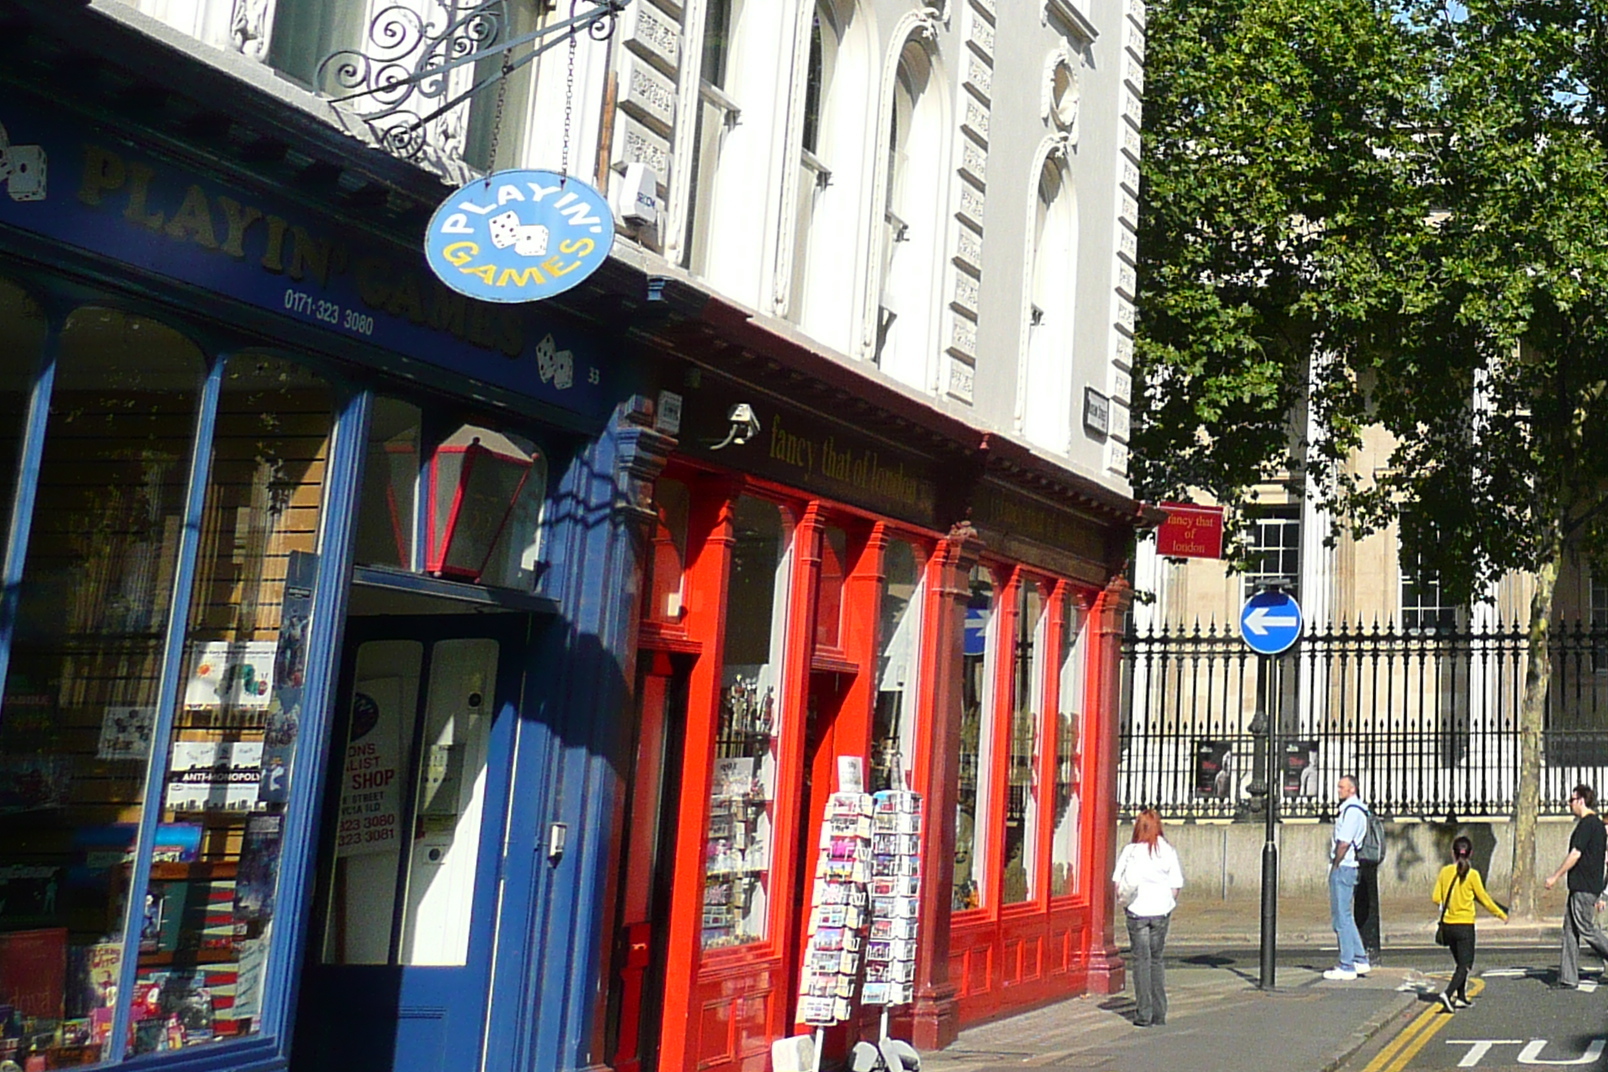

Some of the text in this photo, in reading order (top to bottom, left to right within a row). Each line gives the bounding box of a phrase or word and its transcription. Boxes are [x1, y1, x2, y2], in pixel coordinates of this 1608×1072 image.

[79, 146, 349, 287] PLAYIN'
[441, 182, 602, 234] PLAYIN'
[443, 237, 595, 287] GAMES
[343, 308, 374, 336] 3080
[588, 366, 600, 385] 33
[769, 413, 813, 481] fancy
[822, 436, 852, 481] that
[853, 449, 871, 489] of
[1167, 513, 1214, 529] fancy that
[1184, 528, 1197, 539] of
[1172, 539, 1205, 553] london
[352, 768, 395, 790] SHOP
[352, 791, 384, 804] STREET
[363, 813, 395, 830] 3080
[364, 828, 395, 843] 3081
